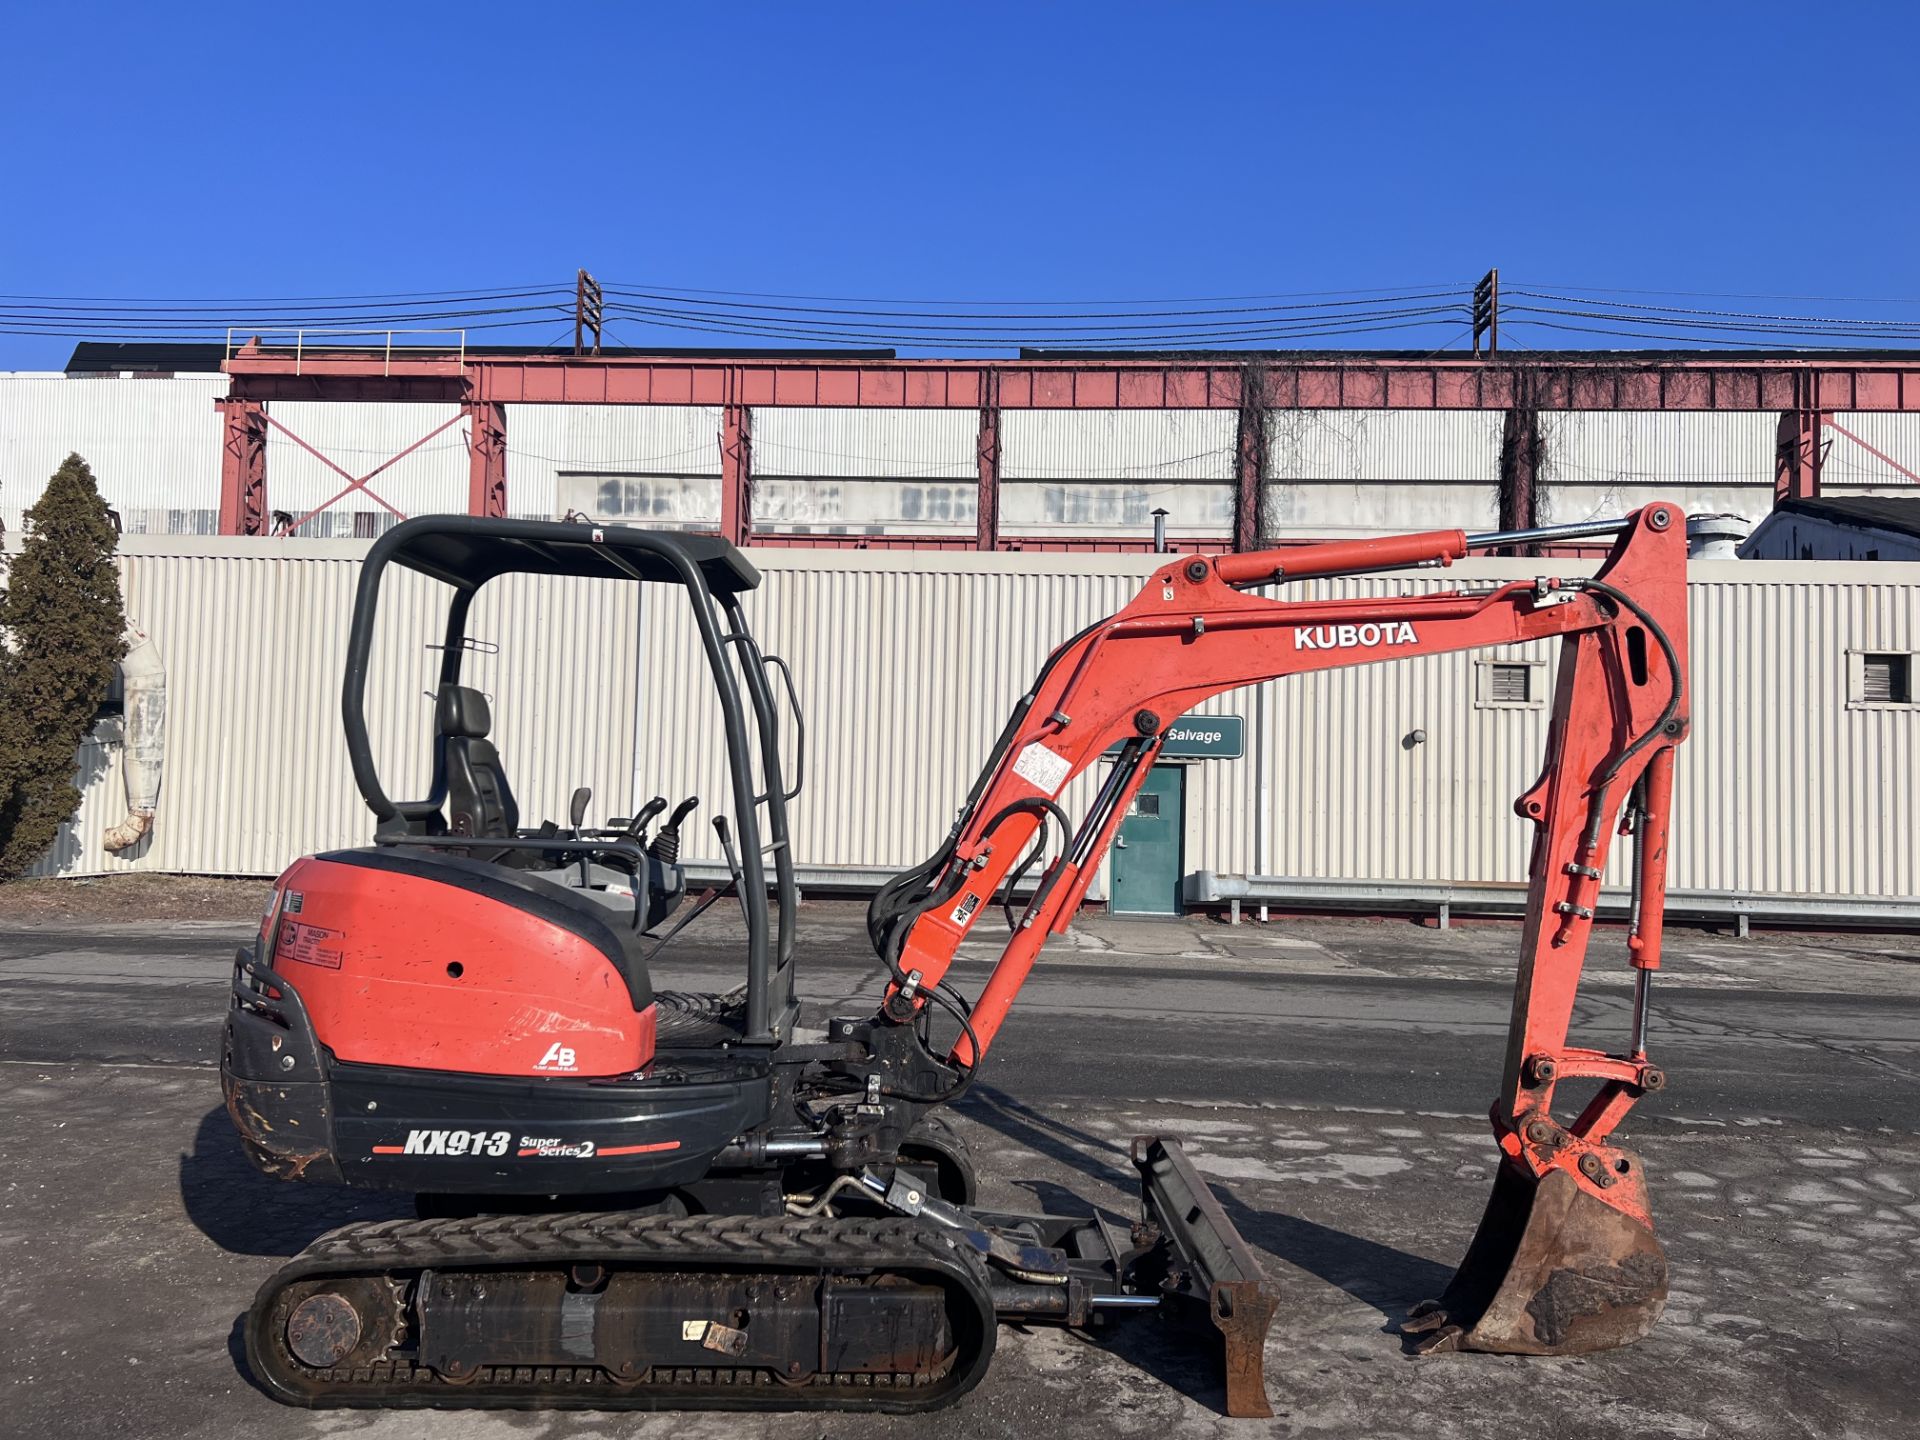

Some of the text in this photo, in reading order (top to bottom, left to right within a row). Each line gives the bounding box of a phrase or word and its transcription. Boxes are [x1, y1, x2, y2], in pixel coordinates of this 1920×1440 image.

[1294, 620, 1418, 650] KUBOTA
[1168, 728, 1222, 744] Salvage
[538, 1041, 576, 1067] AB
[403, 1130, 511, 1157] KX91-3
[519, 1136, 561, 1149] Super
